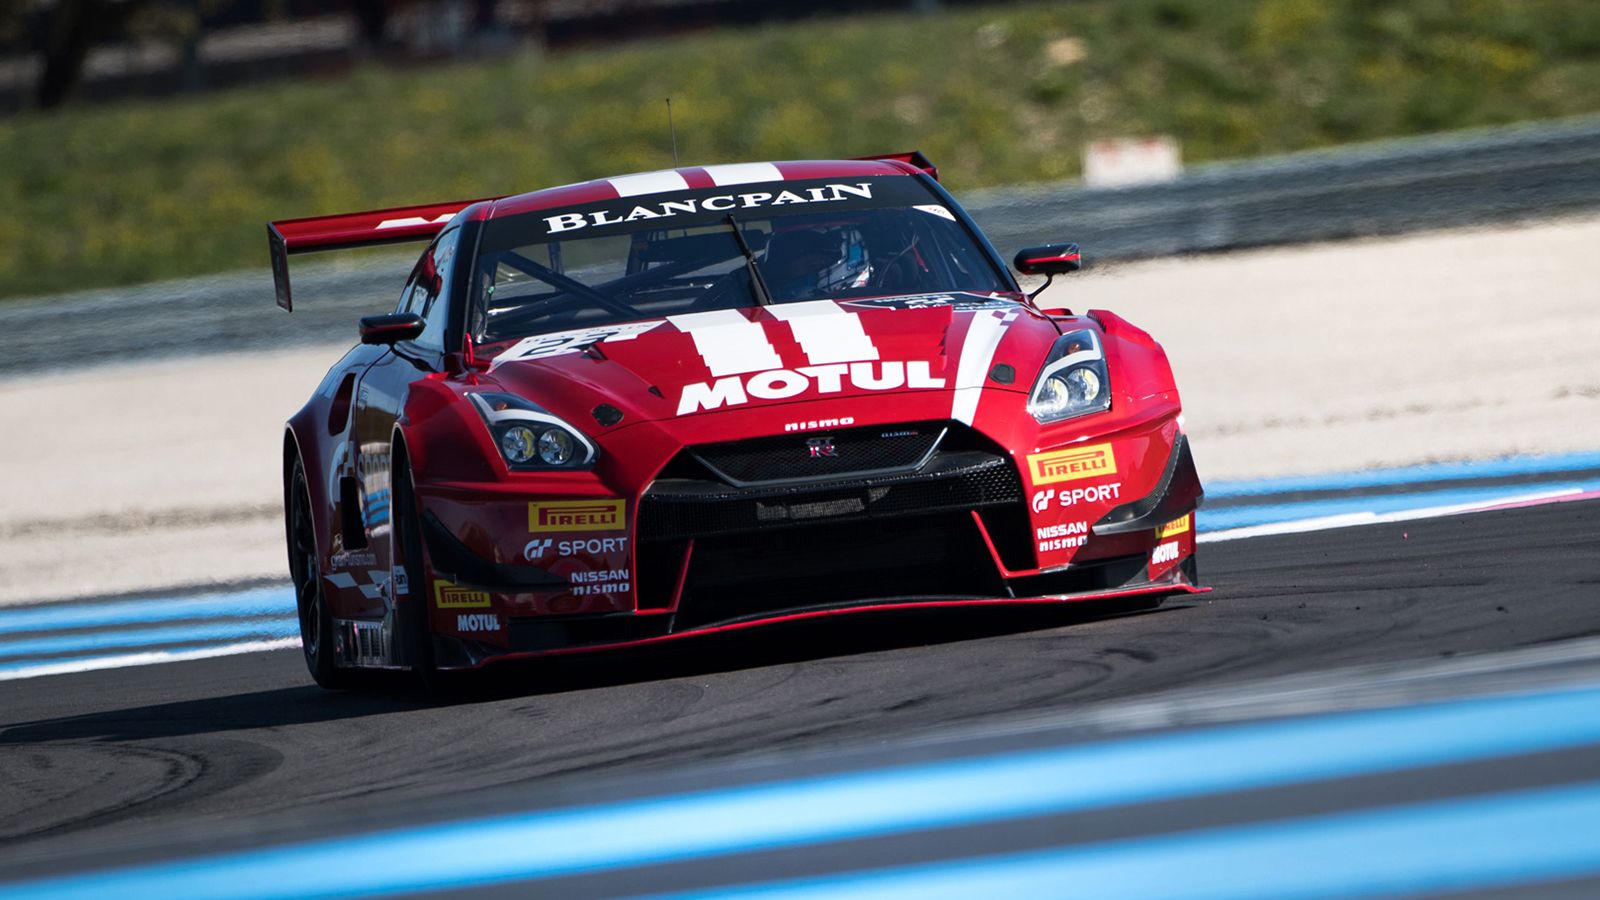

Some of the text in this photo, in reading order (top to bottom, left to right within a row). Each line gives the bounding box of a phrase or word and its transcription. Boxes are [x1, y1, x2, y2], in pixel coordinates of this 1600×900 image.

[543, 183, 872, 234] BLANCPAIN
[676, 361, 946, 416] MOTUL
[785, 417, 854, 432] nismo
[1036, 450, 1107, 478] PIRELLI
[1059, 483, 1121, 506] SPORT
[538, 505, 617, 526] PIRELLI
[1037, 521, 1088, 540] NISSAN
[558, 537, 627, 556] SPORT
[1152, 541, 1179, 565] MOTUL
[571, 569, 629, 583] NISSAN
[440, 587, 485, 603] PIRELLI
[457, 614, 501, 631] MOTUL
